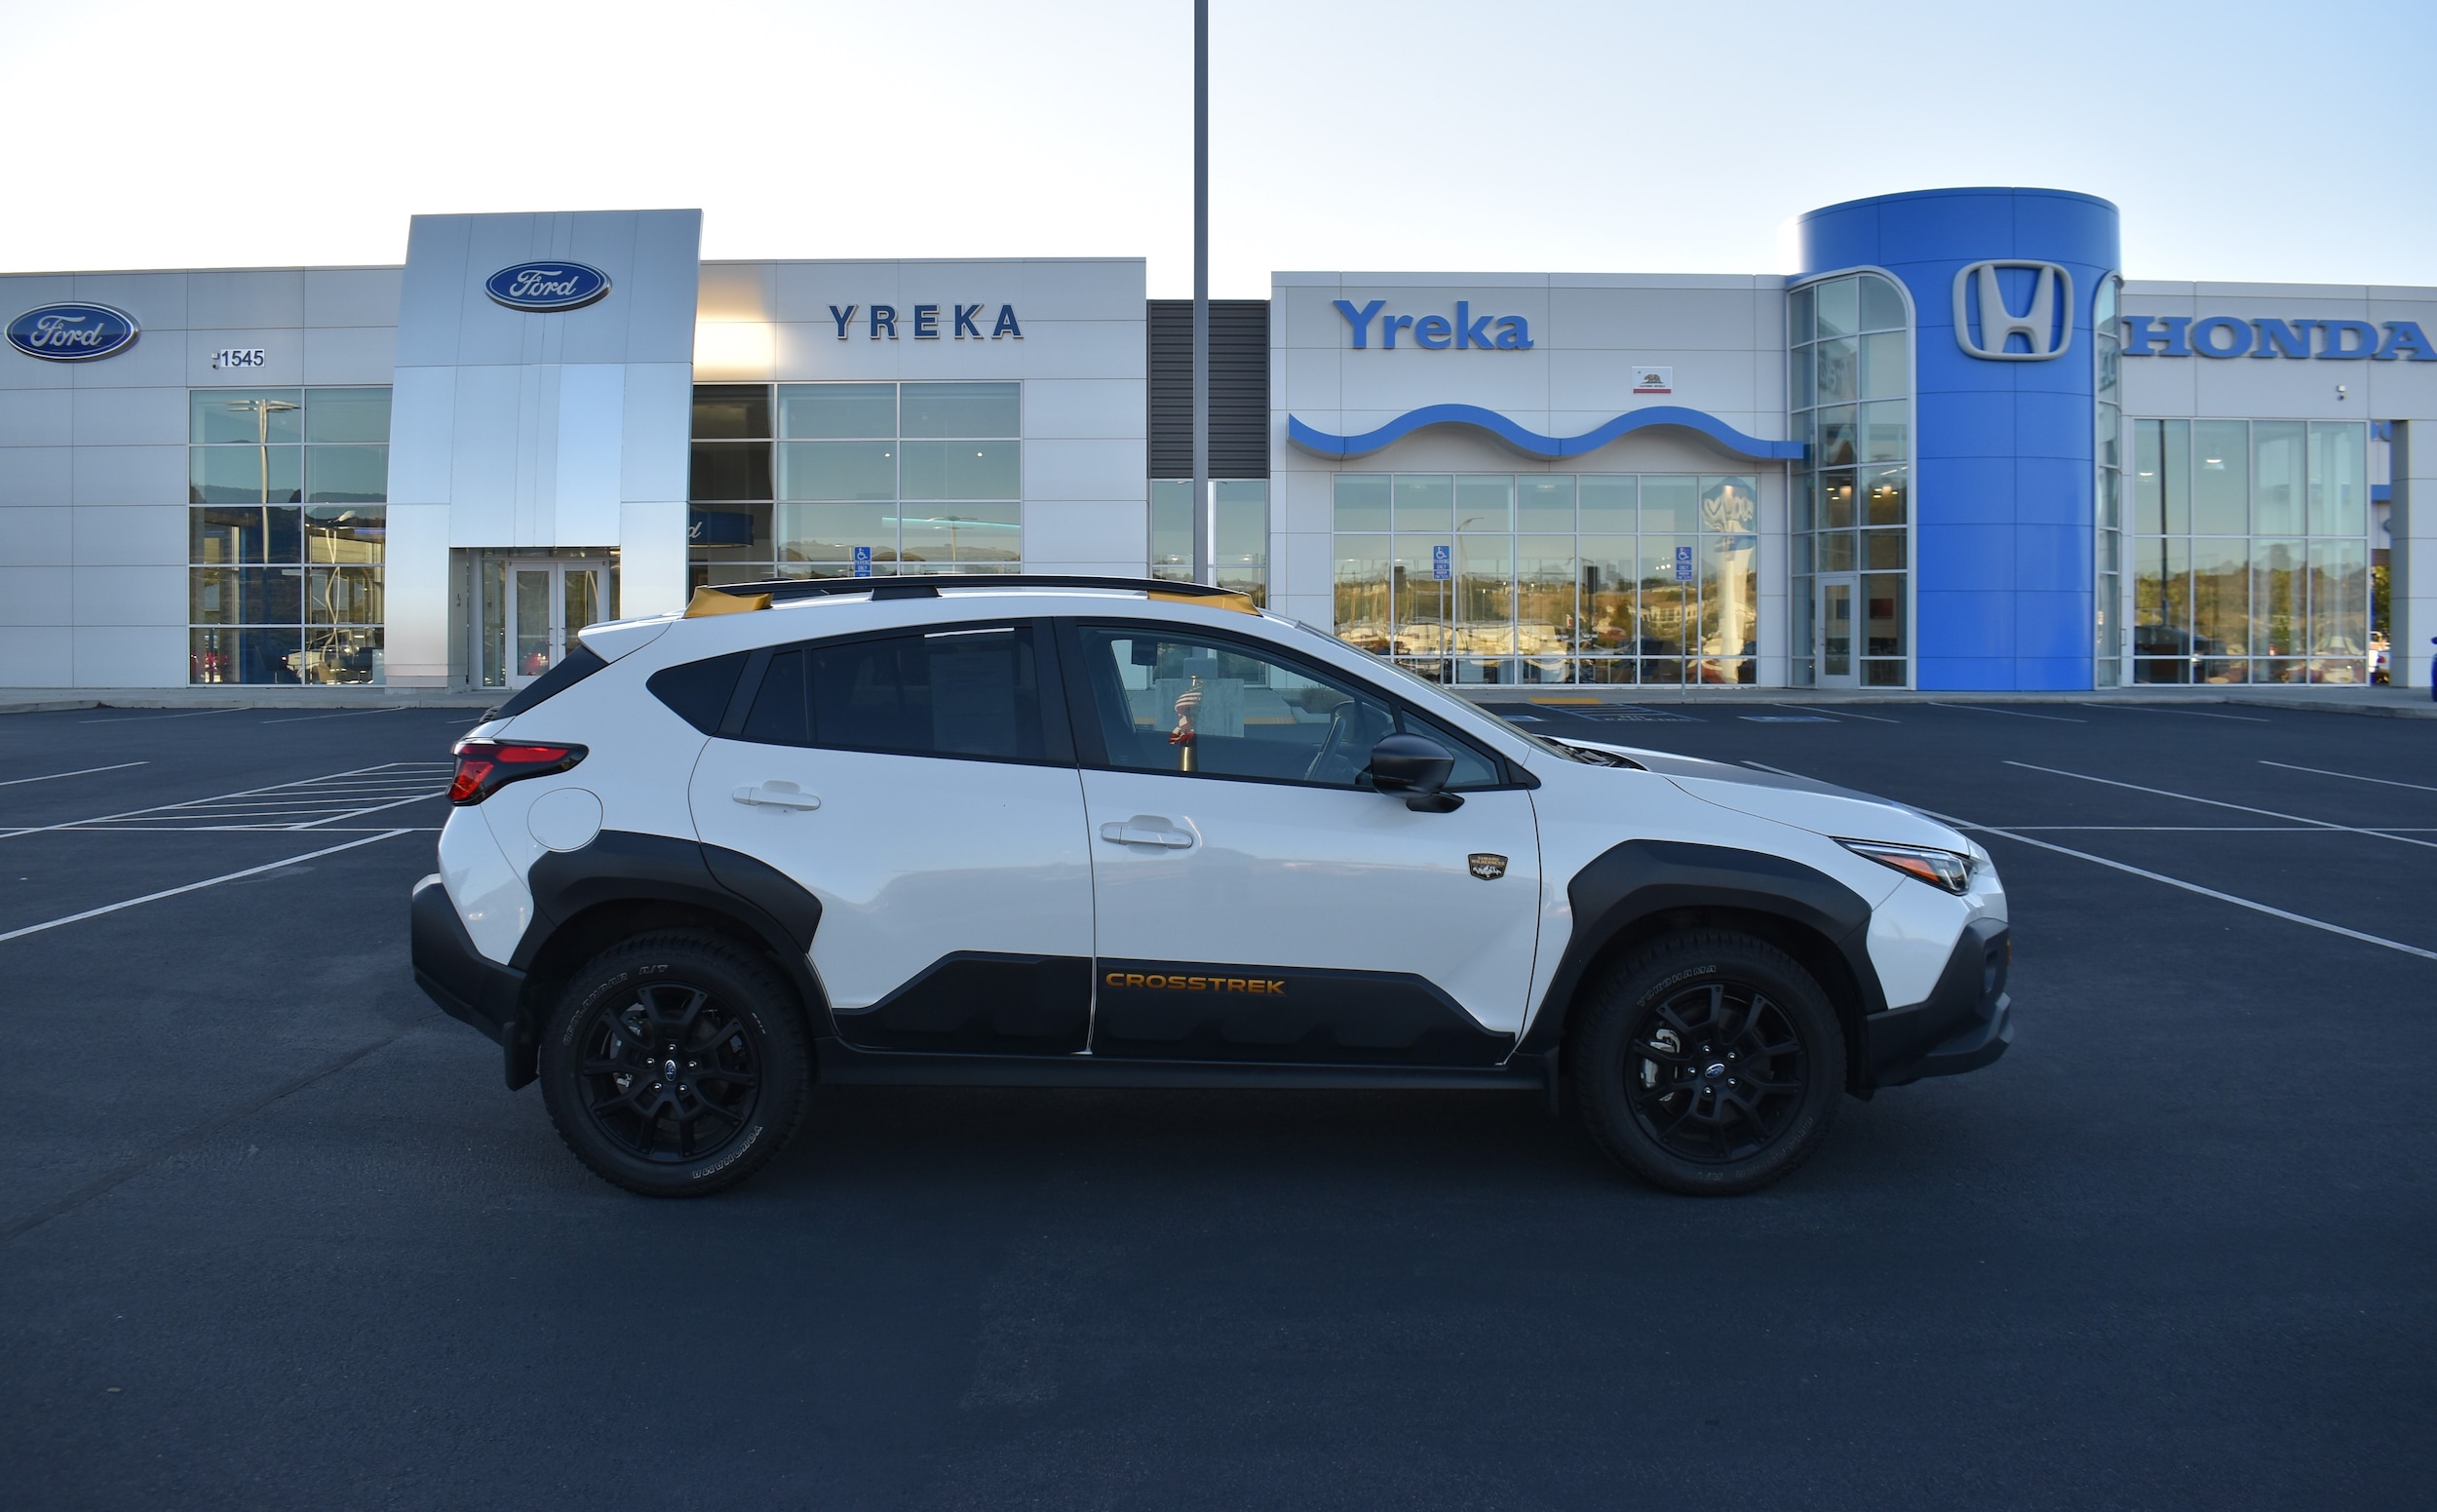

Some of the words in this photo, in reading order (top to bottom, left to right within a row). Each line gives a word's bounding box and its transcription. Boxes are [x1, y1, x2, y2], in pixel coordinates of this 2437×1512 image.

[509, 269, 579, 296] Ford
[30, 315, 104, 346] Ford
[829, 304, 1024, 338] YREKA
[1333, 299, 1534, 349] Yreka
[2121, 315, 2437, 361] HONDA
[221, 350, 264, 367] 1545
[1105, 973, 1286, 994] CROSSTREK
[1637, 964, 1717, 1007] YOKOHAMA
[562, 972, 629, 1046] GEOLANDAR
[638, 964, 669, 976] A/T
[691, 1125, 763, 1180] YOKOHAMA
